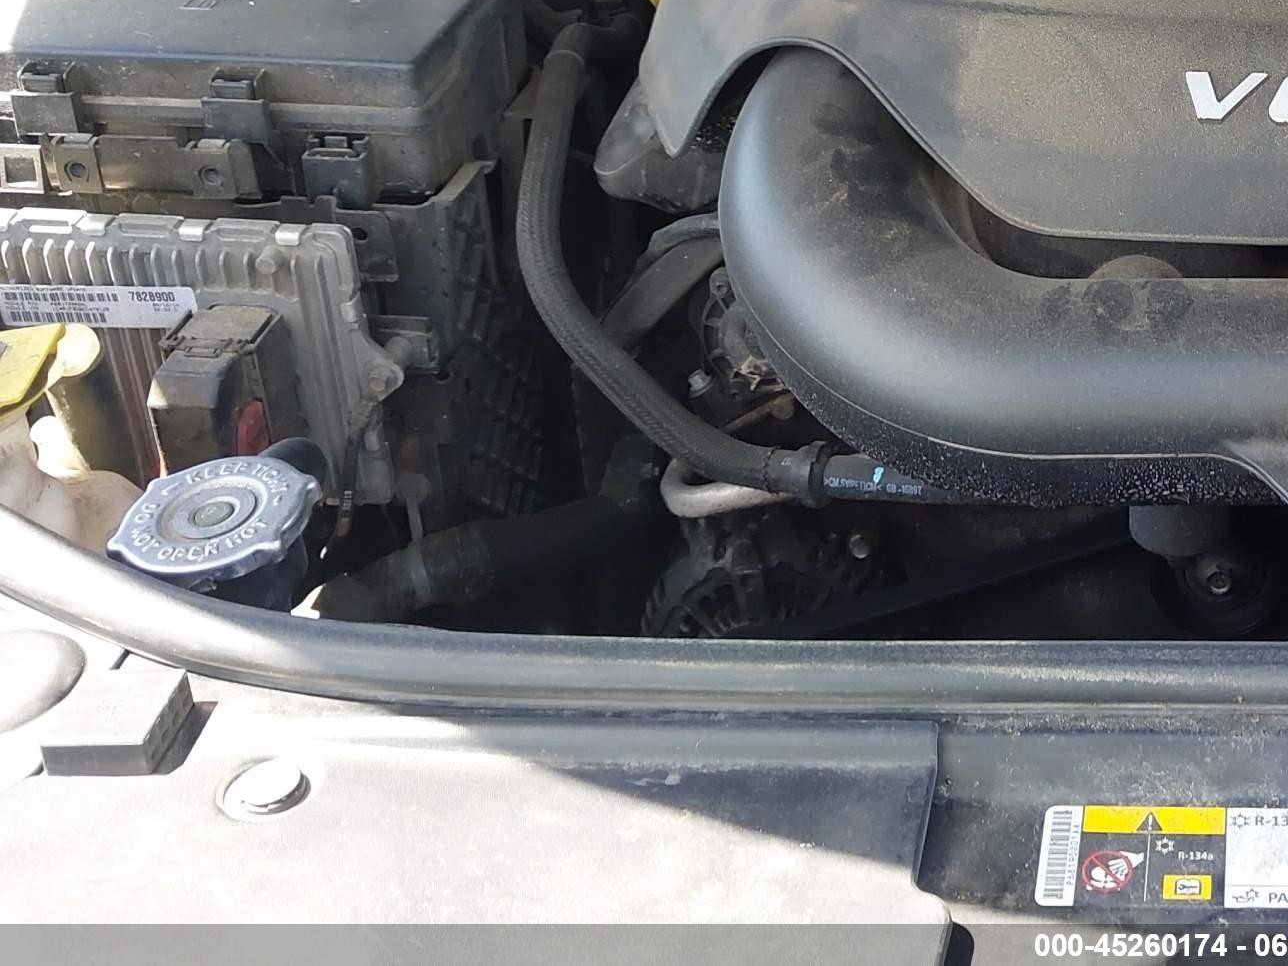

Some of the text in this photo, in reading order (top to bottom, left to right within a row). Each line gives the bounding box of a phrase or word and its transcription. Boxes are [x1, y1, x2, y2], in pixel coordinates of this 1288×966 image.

[127, 290, 176, 302] 7828900
[185, 462, 249, 485] KEEP
[1177, 849, 1215, 862] R-134a
